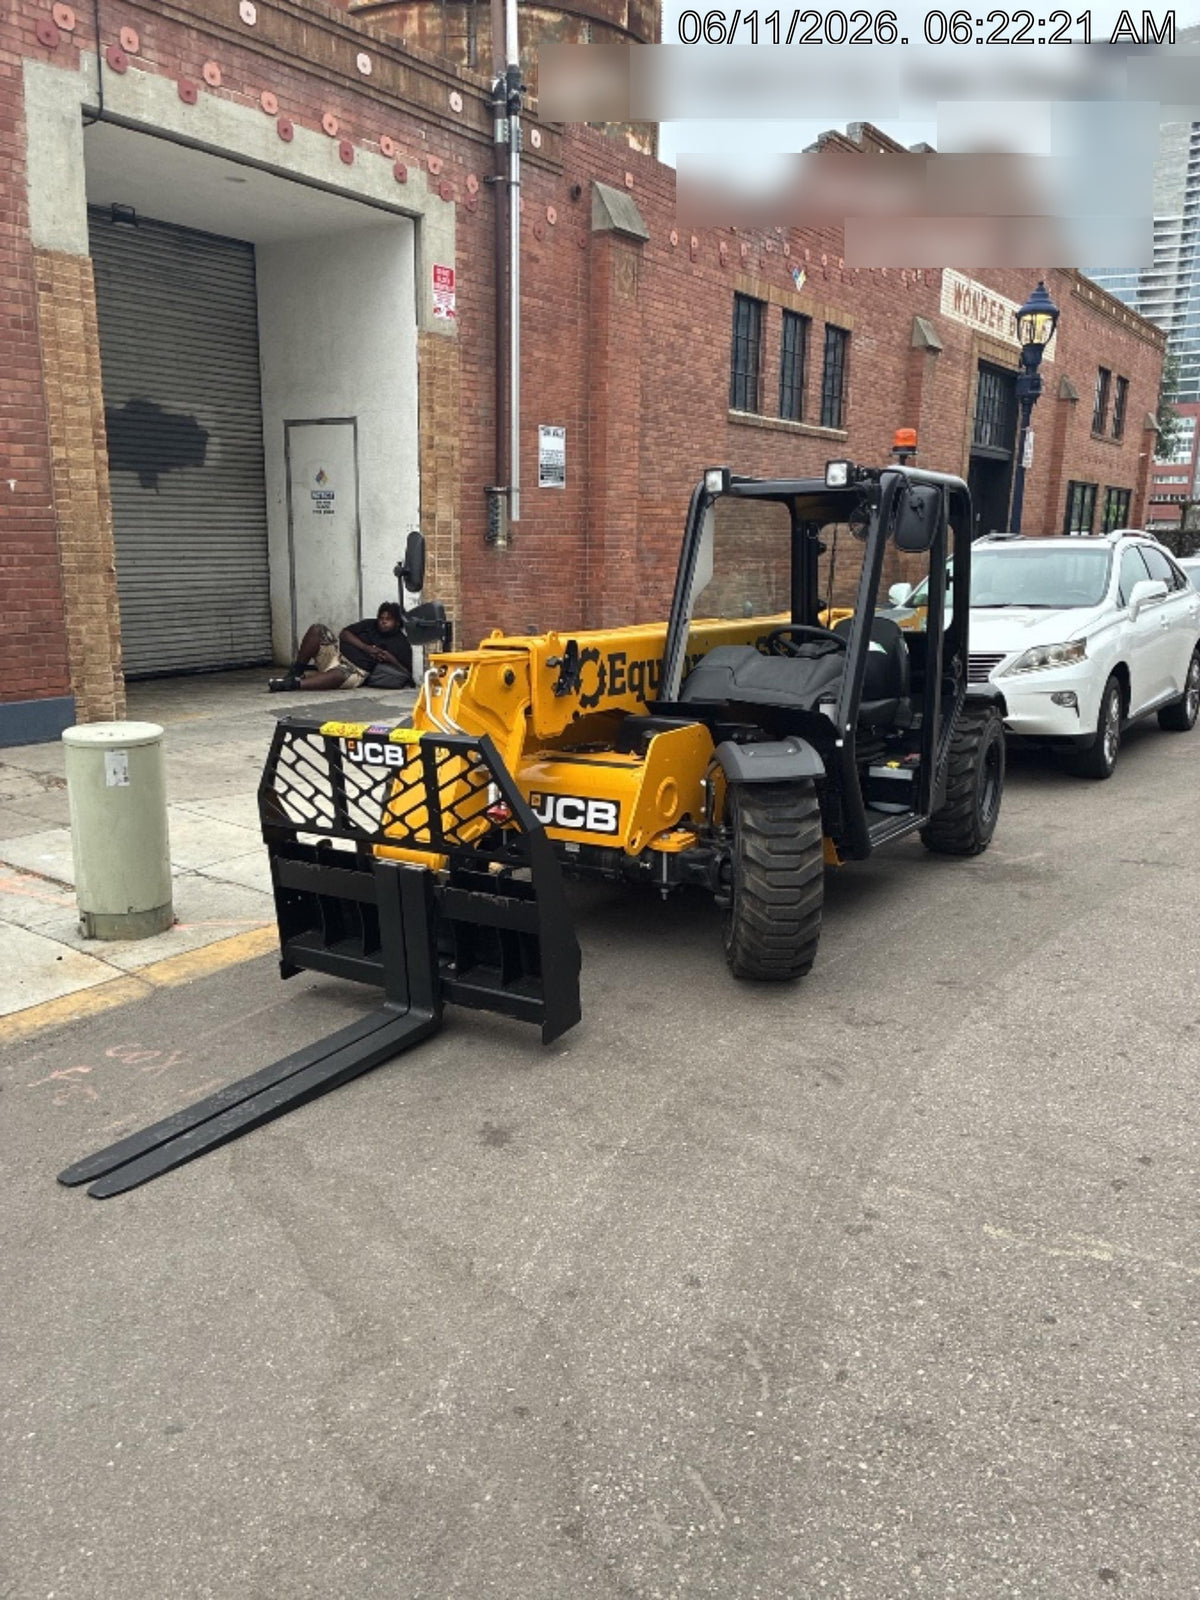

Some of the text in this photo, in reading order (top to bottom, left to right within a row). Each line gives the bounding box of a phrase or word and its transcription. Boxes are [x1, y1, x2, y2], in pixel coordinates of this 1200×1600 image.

[953, 280, 1006, 332] WONDER
[348, 740, 404, 766] JCB
[531, 795, 618, 831] JCB
